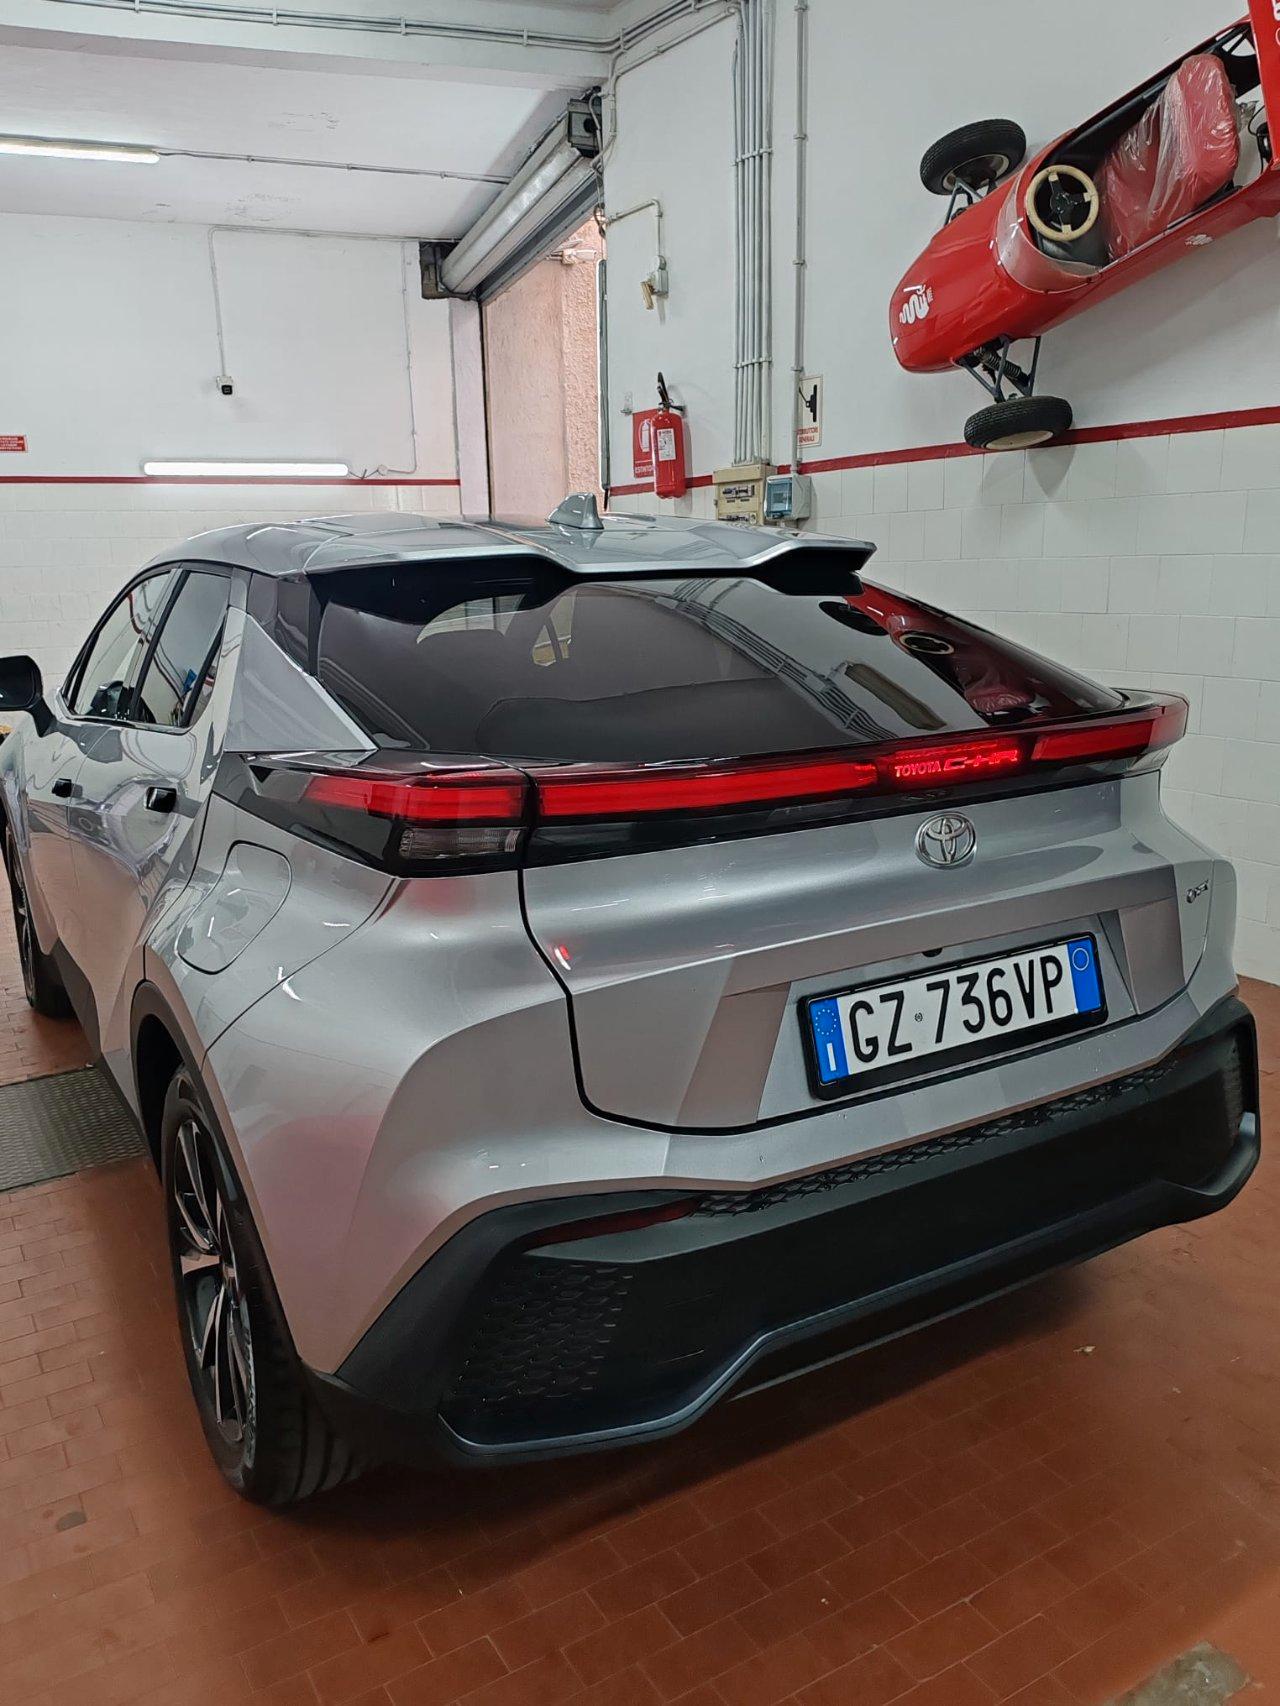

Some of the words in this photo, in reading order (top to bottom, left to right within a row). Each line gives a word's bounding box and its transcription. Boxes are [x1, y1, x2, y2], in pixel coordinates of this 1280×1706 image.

[895, 761, 941, 778] TOYOTA
[849, 990, 913, 1063] GZ
[926, 954, 1064, 1044] 736VP
